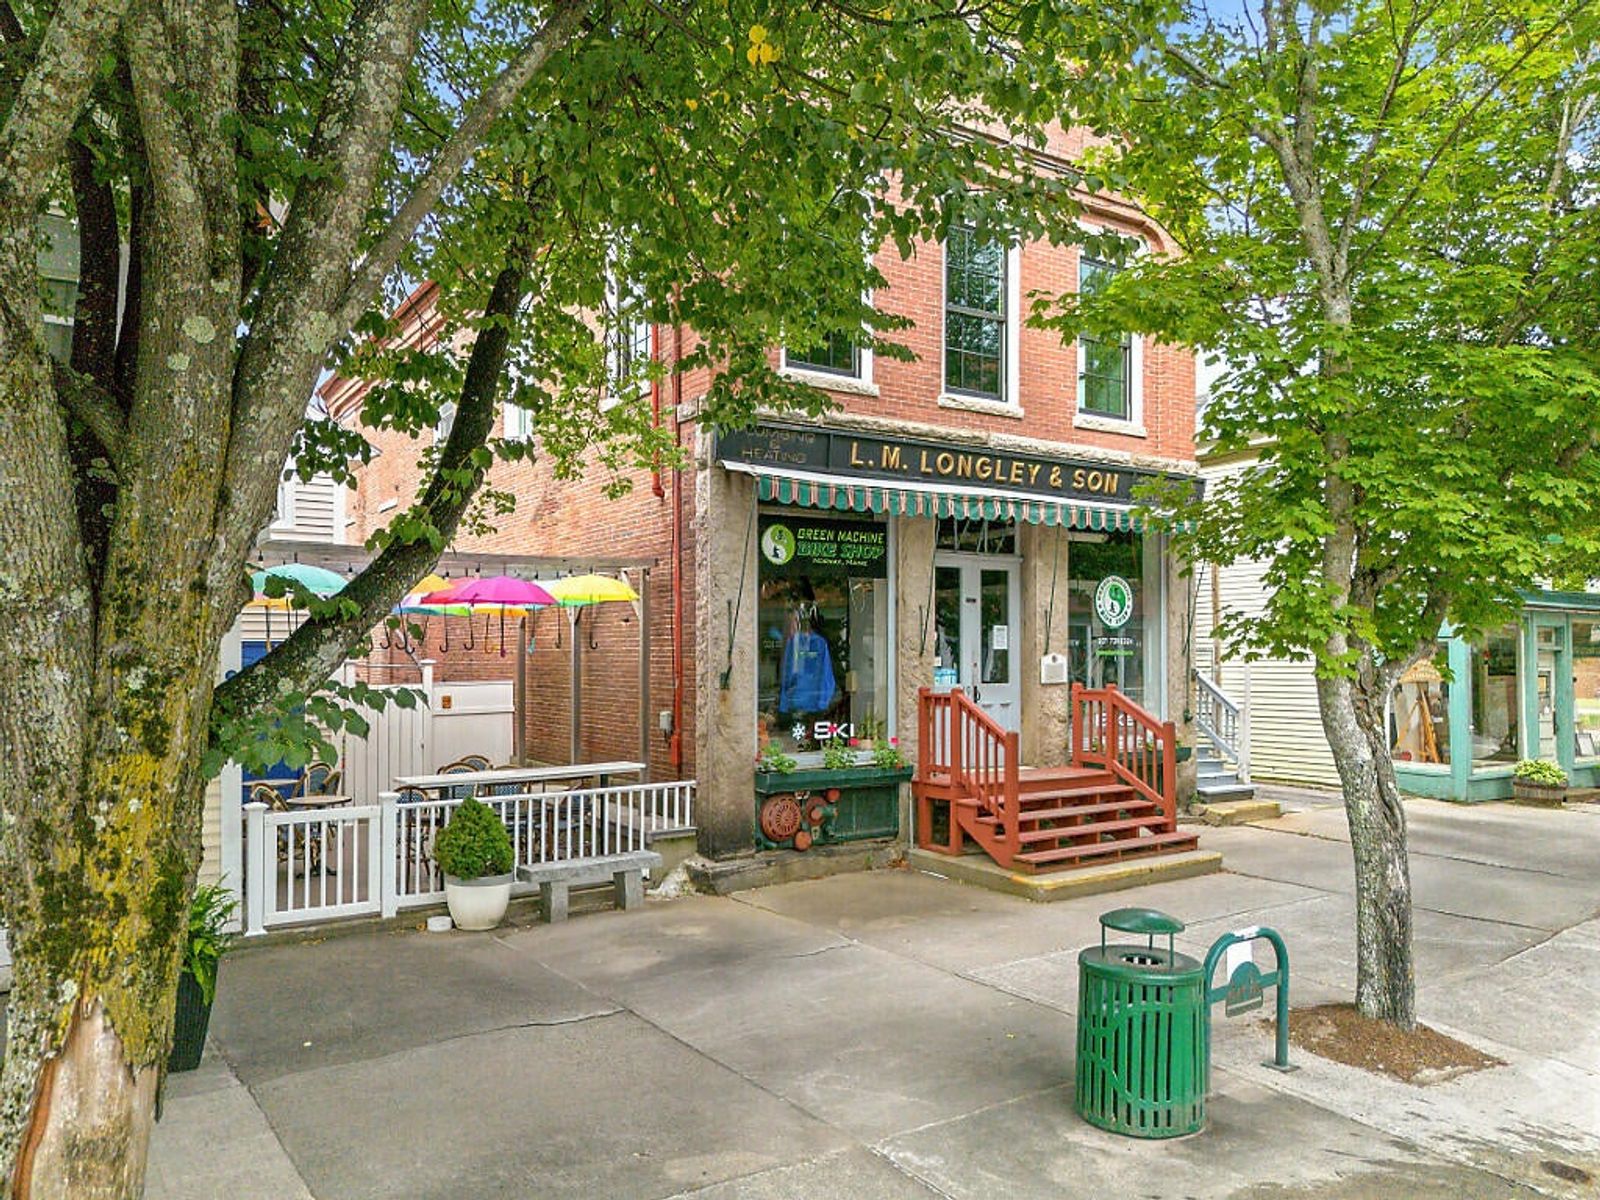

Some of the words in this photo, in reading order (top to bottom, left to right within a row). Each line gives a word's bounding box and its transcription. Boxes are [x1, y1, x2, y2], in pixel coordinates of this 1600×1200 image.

[743, 447, 808, 464] HEATING
[851, 441, 874, 467] L.
[881, 445, 908, 470] M.
[920, 450, 1041, 486] LONGLEY
[1050, 465, 1063, 488] &
[1072, 469, 1119, 495] SON
[797, 528, 834, 541] GREEN
[837, 530, 885, 544] MACHINE
[840, 543, 885, 560] SHOP
[814, 722, 855, 739] SKI
